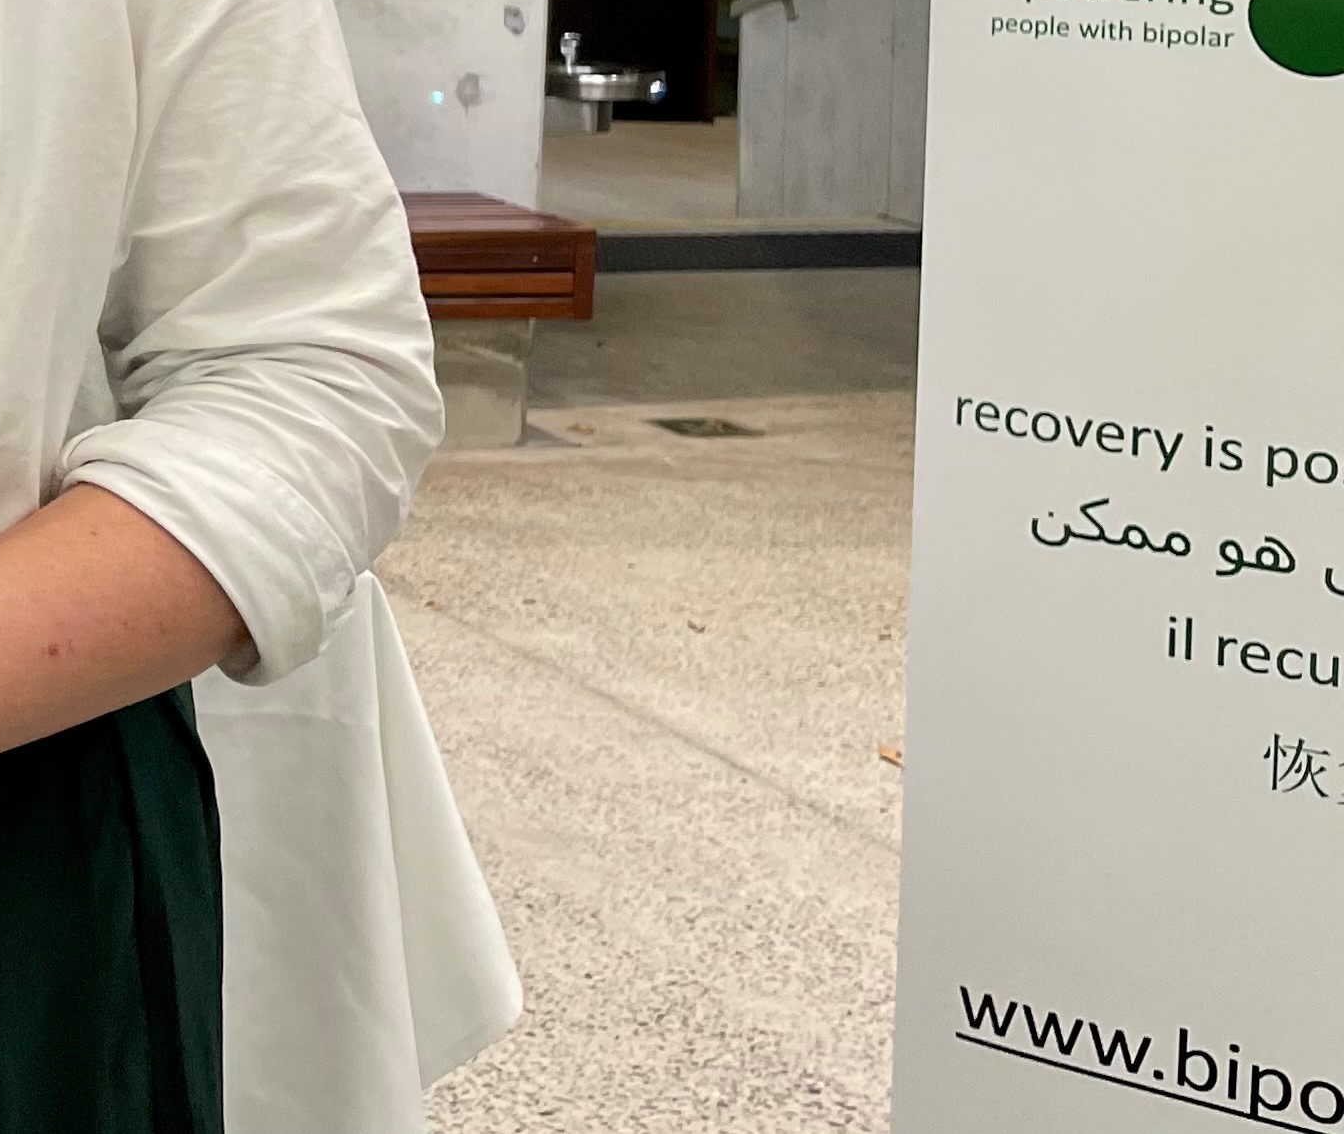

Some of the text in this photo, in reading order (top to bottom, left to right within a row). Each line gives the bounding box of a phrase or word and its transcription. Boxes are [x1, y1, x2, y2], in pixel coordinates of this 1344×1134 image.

[991, 14, 1234, 50] people with bipolar
[956, 396, 1344, 487] recovery is po
[1030, 498, 1295, 576] هو ممكن
[1167, 615, 1339, 688] il recu
[1263, 733, 1344, 805] 恢
[957, 985, 1344, 1127] www.bipo
